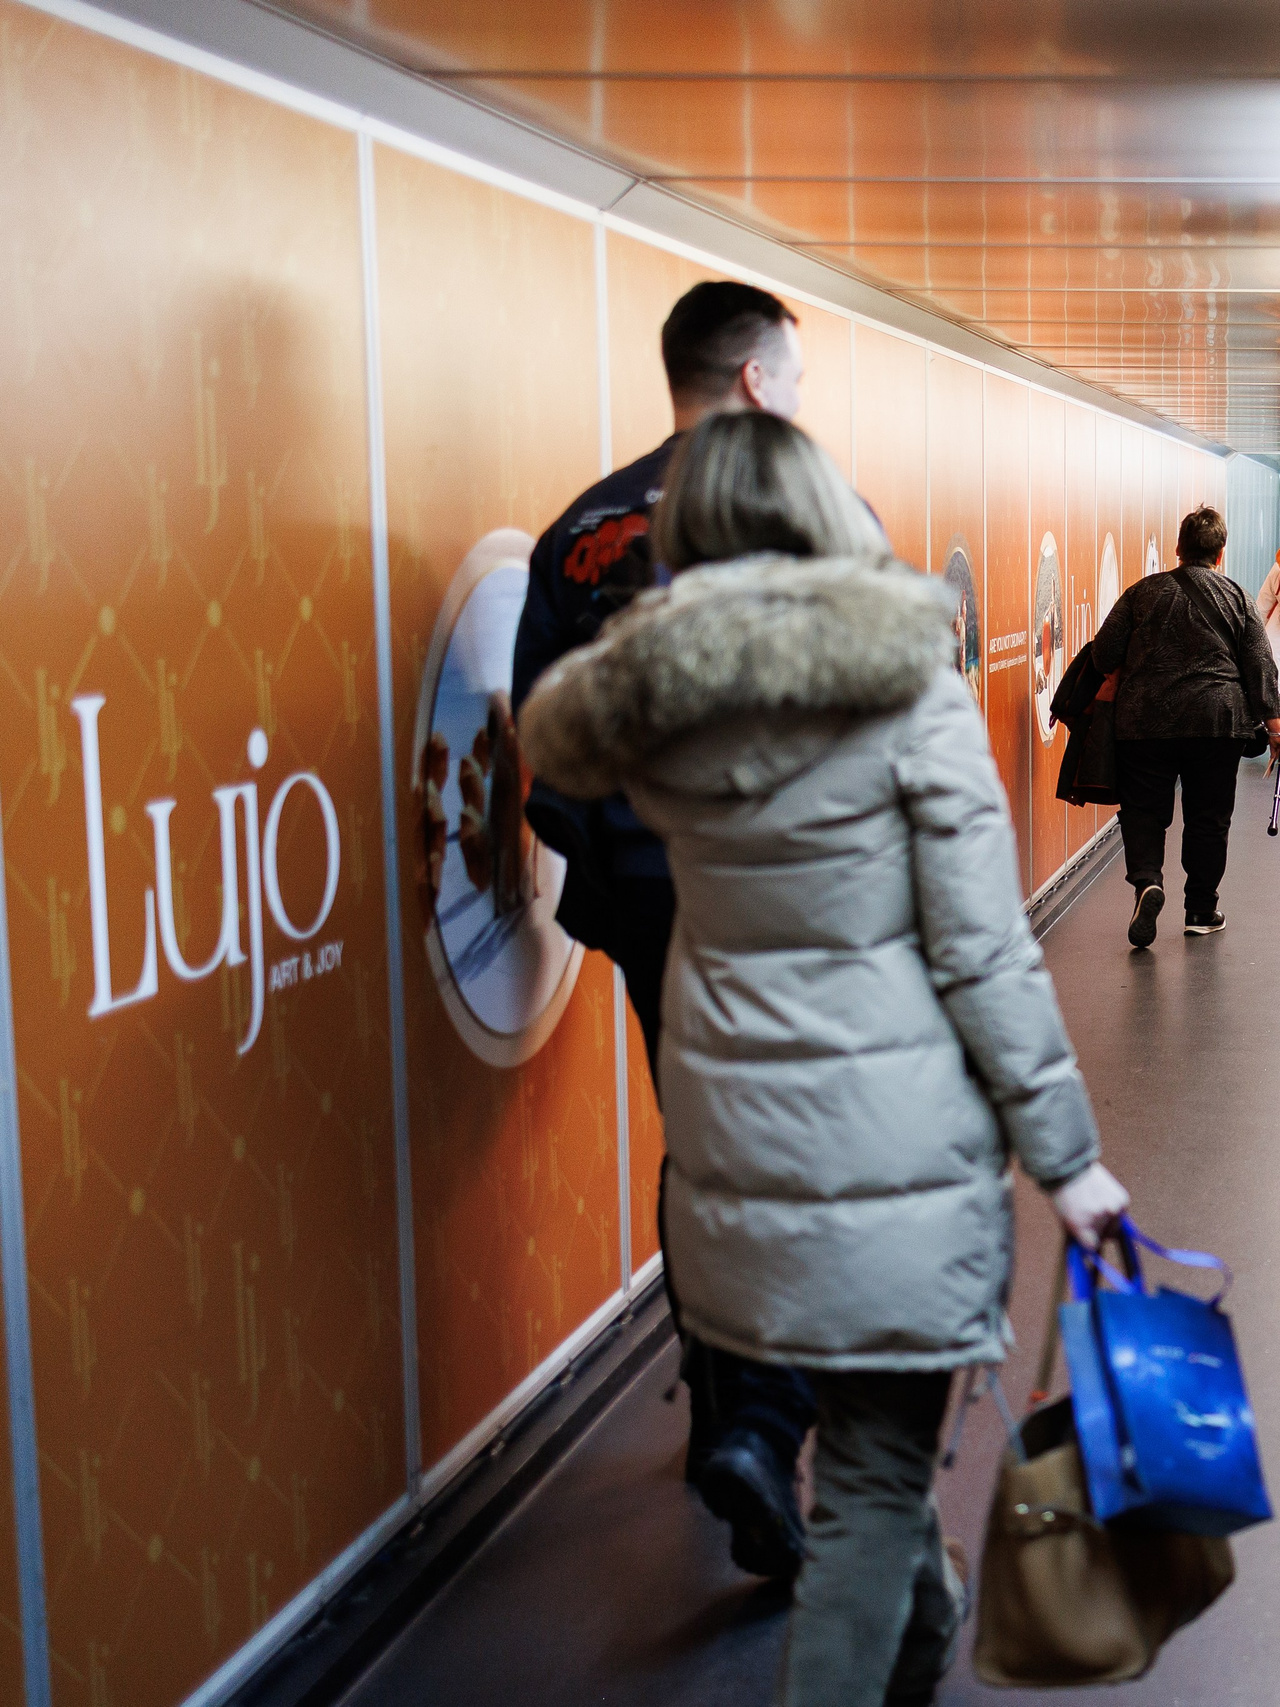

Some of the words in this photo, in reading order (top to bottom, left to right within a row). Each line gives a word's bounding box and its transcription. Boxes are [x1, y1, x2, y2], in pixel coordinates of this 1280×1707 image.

[70, 694, 341, 1055] Lujo
[269, 956, 299, 993] ART
[316, 940, 344, 975] JOY
